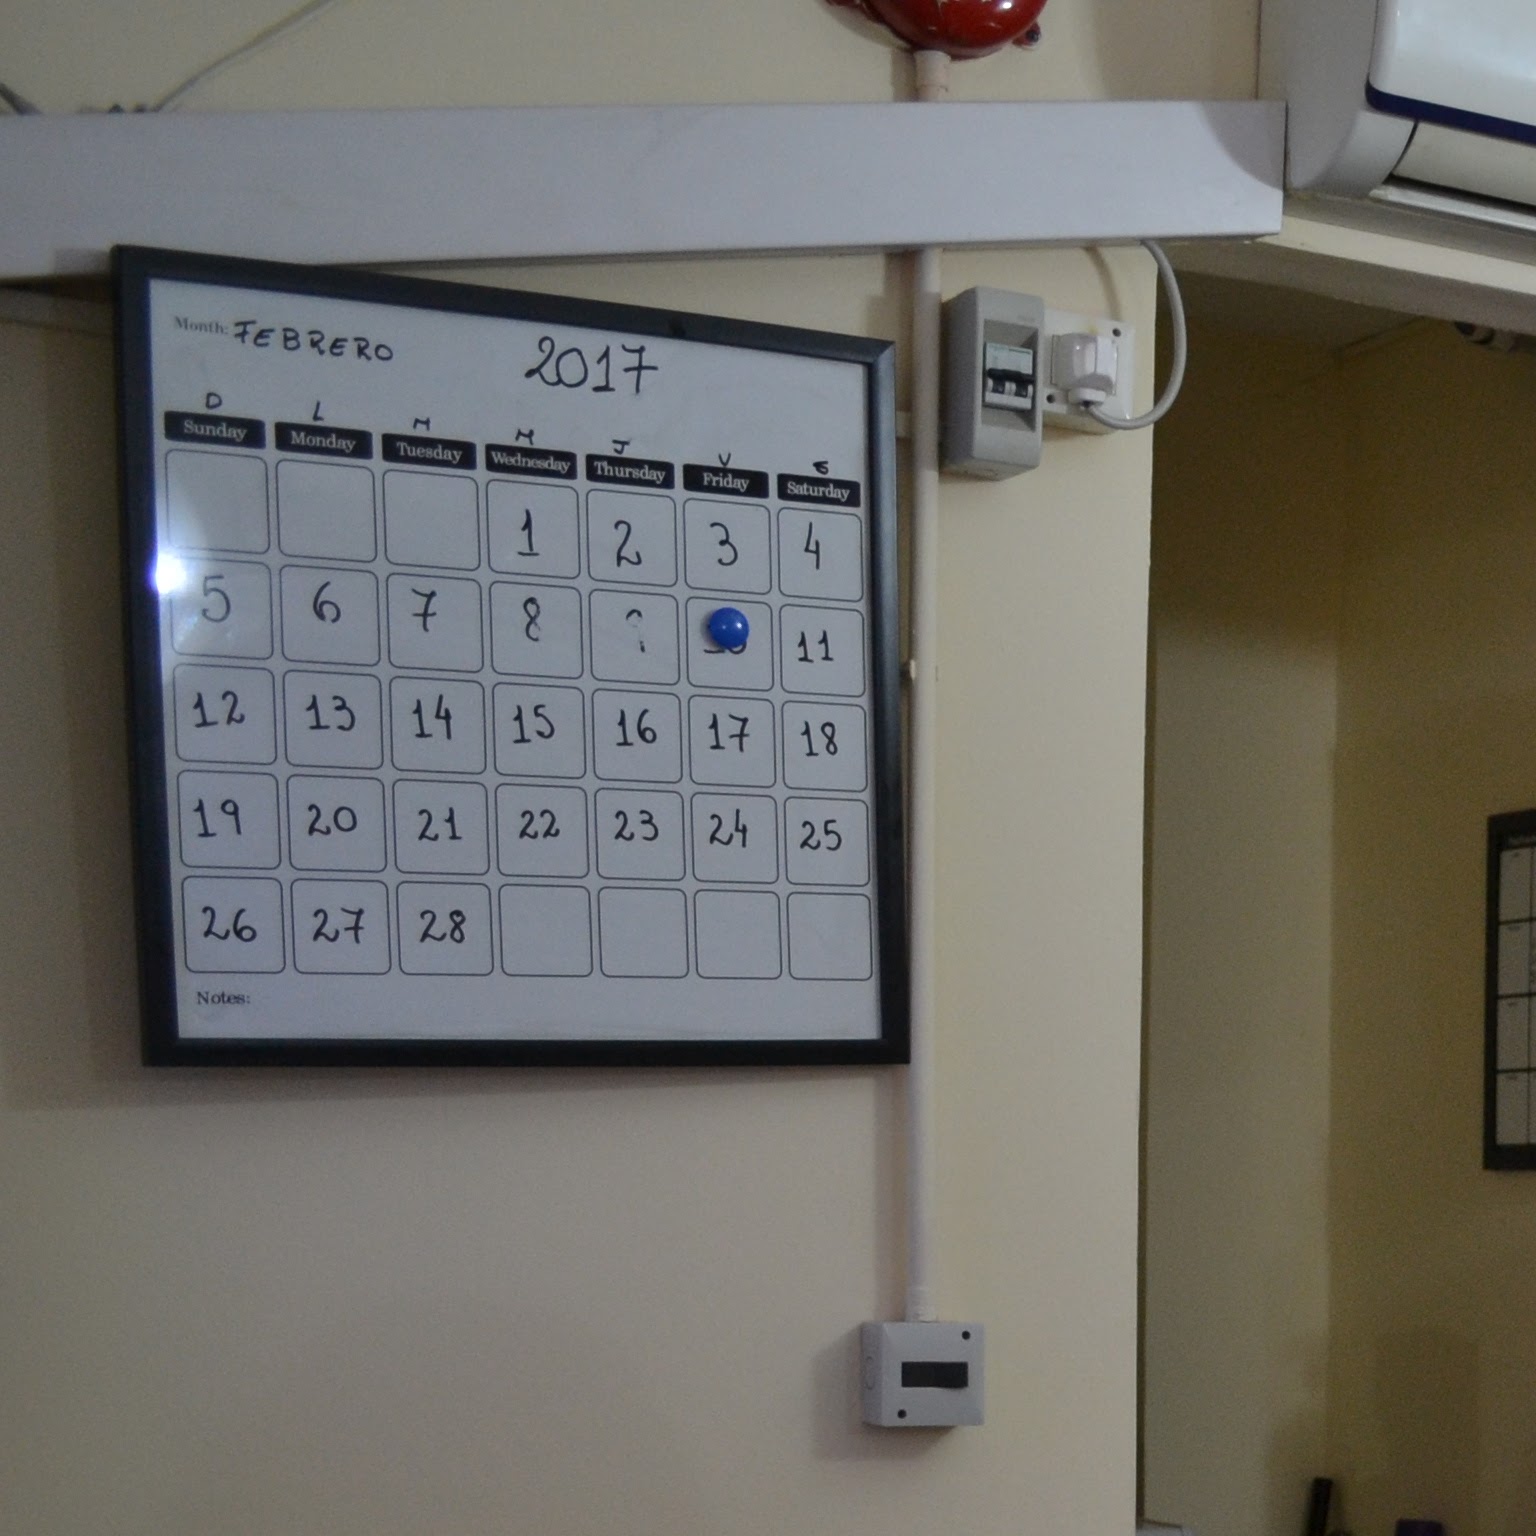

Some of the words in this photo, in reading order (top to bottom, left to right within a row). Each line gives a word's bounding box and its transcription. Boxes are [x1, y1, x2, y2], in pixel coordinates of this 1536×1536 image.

[174, 315, 232, 337] Month:
[234, 320, 394, 362] FEBRERO
[524, 335, 660, 395] 2017
[183, 419, 248, 442] Sunday
[291, 430, 356, 452] Monday
[397, 441, 463, 463] Tuesday
[491, 451, 572, 473] Wednesday
[594, 461, 666, 484] Thursday
[703, 472, 751, 492] Friday
[787, 481, 851, 502] Saturday
[517, 508, 540, 557] 1
[613, 519, 643, 568] 2
[709, 521, 739, 567] 3
[803, 521, 821, 571] 4
[201, 574, 232, 623] 5
[312, 581, 342, 624] 6
[411, 588, 437, 633] 7
[522, 596, 541, 642] 8
[797, 629, 834, 663] 11
[192, 690, 246, 729] 12
[305, 694, 356, 732] 13
[412, 693, 452, 741] 14
[512, 703, 555, 744] 15
[615, 708, 657, 747] 16
[708, 712, 750, 753] 17
[800, 720, 838, 757] 18
[193, 798, 242, 838] 19
[307, 803, 358, 837] 20
[417, 806, 463, 842] 21
[518, 808, 561, 840] 22
[614, 809, 659, 842] 23
[709, 808, 748, 848] 24
[799, 819, 843, 852] 25
[201, 905, 257, 943] 26
[312, 907, 365, 945] 27
[419, 909, 467, 944] 28
[197, 990, 251, 1006] Notes:
